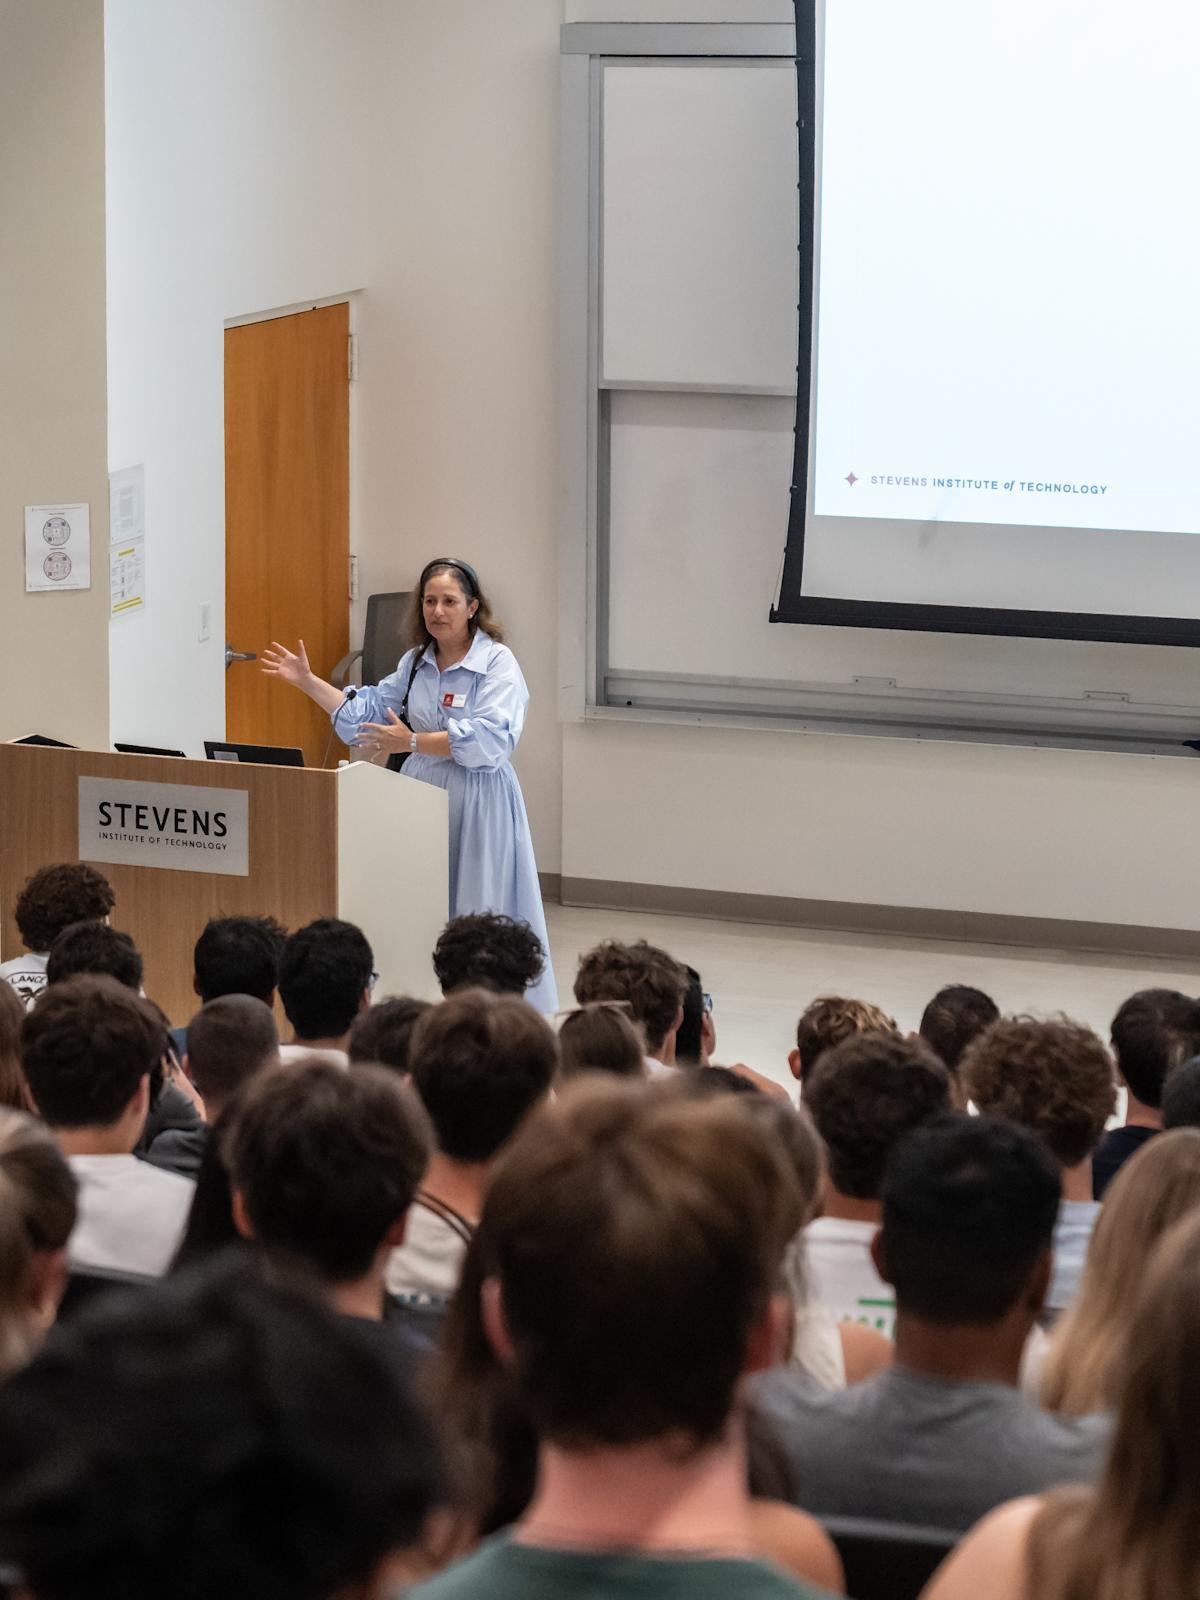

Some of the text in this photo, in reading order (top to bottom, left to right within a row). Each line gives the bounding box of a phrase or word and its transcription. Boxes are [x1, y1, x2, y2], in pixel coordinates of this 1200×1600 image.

[871, 475, 1108, 495] STEVENS INSTITUTE of TECHNOLOGY
[98, 801, 228, 837] STEVENS
[98, 831, 228, 851] INSTITUTE OF TECHNOLOGY
